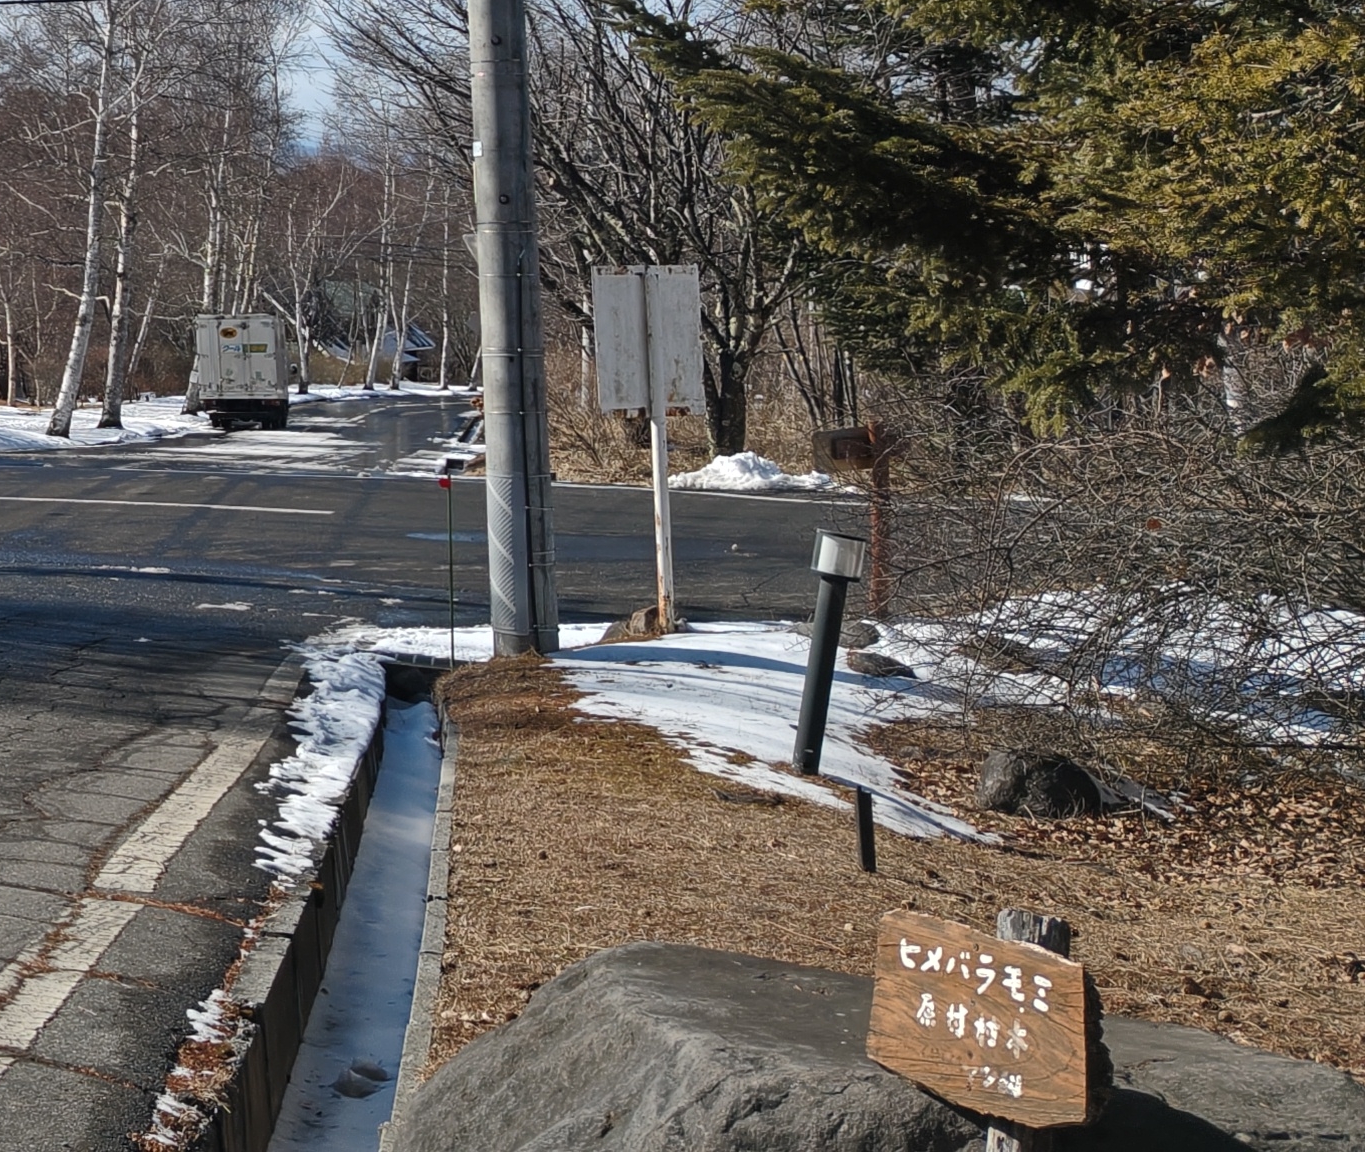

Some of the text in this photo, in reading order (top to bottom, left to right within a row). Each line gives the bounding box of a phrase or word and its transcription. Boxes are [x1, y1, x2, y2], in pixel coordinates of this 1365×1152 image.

[900, 938, 1053, 1012] ヒメバラモミ
